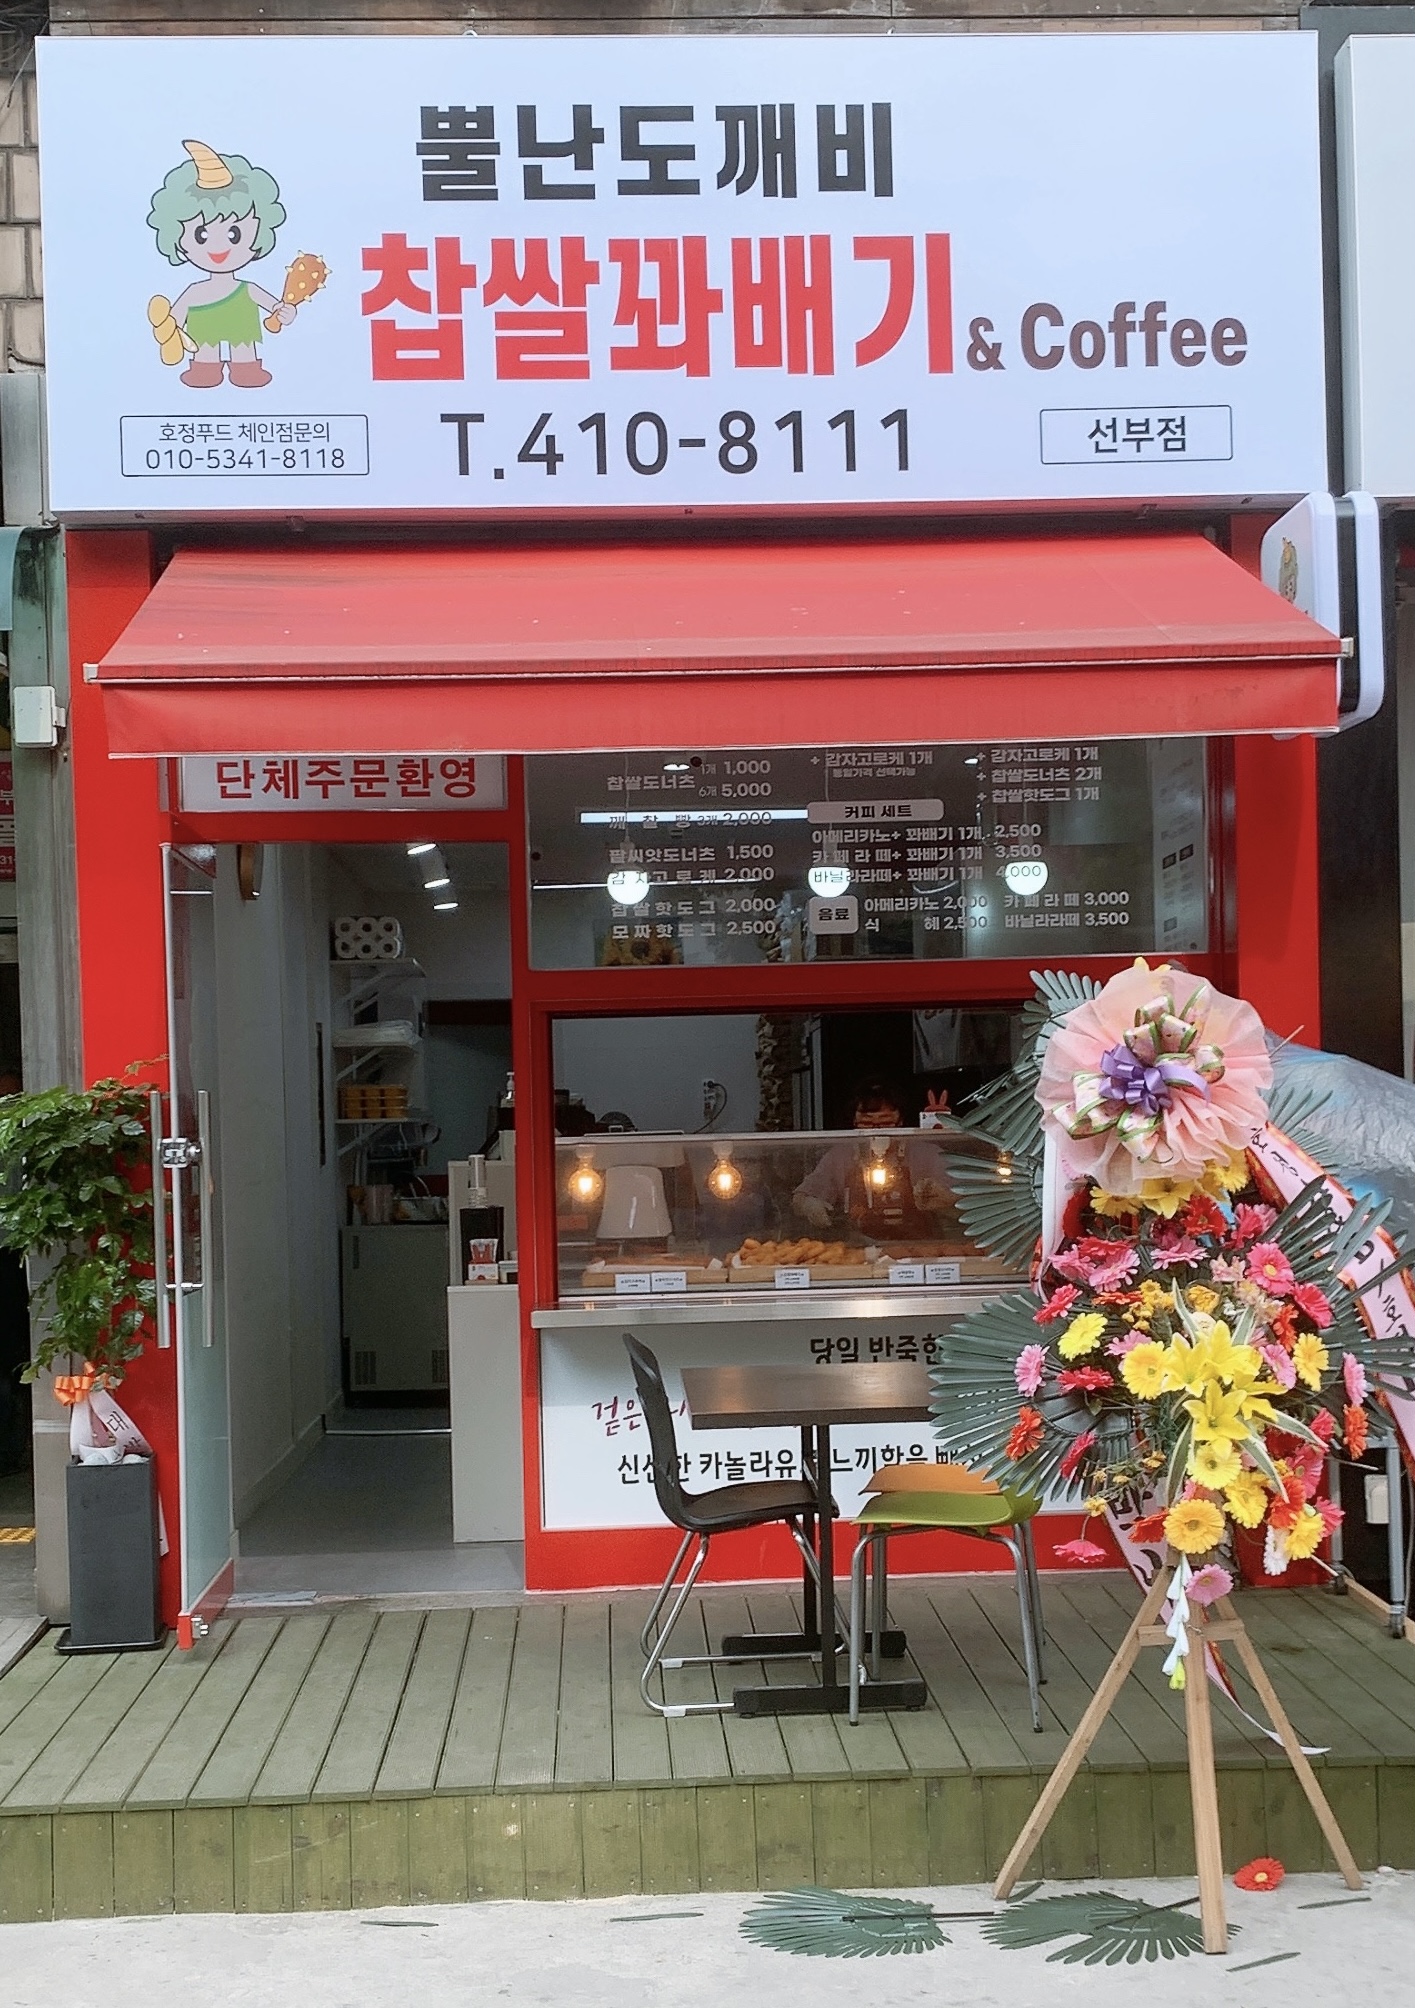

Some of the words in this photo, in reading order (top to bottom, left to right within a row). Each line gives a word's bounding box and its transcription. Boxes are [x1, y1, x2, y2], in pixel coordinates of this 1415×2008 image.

[415, 103, 894, 201] 뿔난도깨비
[361, 233, 954, 380] 찹쌀꽈배기
[966, 317, 1006, 371] &
[1020, 301, 1248, 370] Coffee
[158, 422, 233, 444] 호정푸드
[237, 421, 330, 443] 체인점문의
[1087, 415, 1187, 454] 선부점
[440, 409, 909, 479] T.410-8111
[145, 448, 346, 471] 010-5341-8118
[826, 751, 905, 767] 감자고로케
[991, 747, 1071, 763] 감자고로케
[1074, 746, 1099, 761] 1개
[724, 760, 771, 775] 1,000
[991, 768, 1071, 783] 찹쌀도너츠
[1075, 767, 1102, 781] 2개
[215, 757, 477, 800] 단체주문환영
[606, 774, 696, 791] 찹쌀도너츠
[721, 782, 772, 798] 5,000
[991, 787, 1071, 803] 찹쌀핫도그
[1075, 786, 1099, 801] 1개
[722, 811, 772, 827] 2,000
[844, 805, 876, 819] 커피
[881, 804, 912, 818] 세트
[905, 827, 953, 842] 꽈배기
[994, 823, 1042, 839] 2,500
[726, 844, 774, 861] 1,500
[906, 847, 954, 862] 꽈배기
[995, 844, 1042, 858] 3,500
[723, 867, 775, 882] 2,000
[907, 866, 954, 882] 꽈배기
[725, 897, 776, 914] 2,000
[864, 897, 939, 912] 아메리카노
[943, 895, 988, 911] 2,000
[1084, 891, 1130, 906] 3,000
[817, 907, 850, 921] 음료
[1085, 911, 1130, 927] 3,500
[726, 920, 776, 936] 2,500
[943, 915, 988, 931] 2,500
